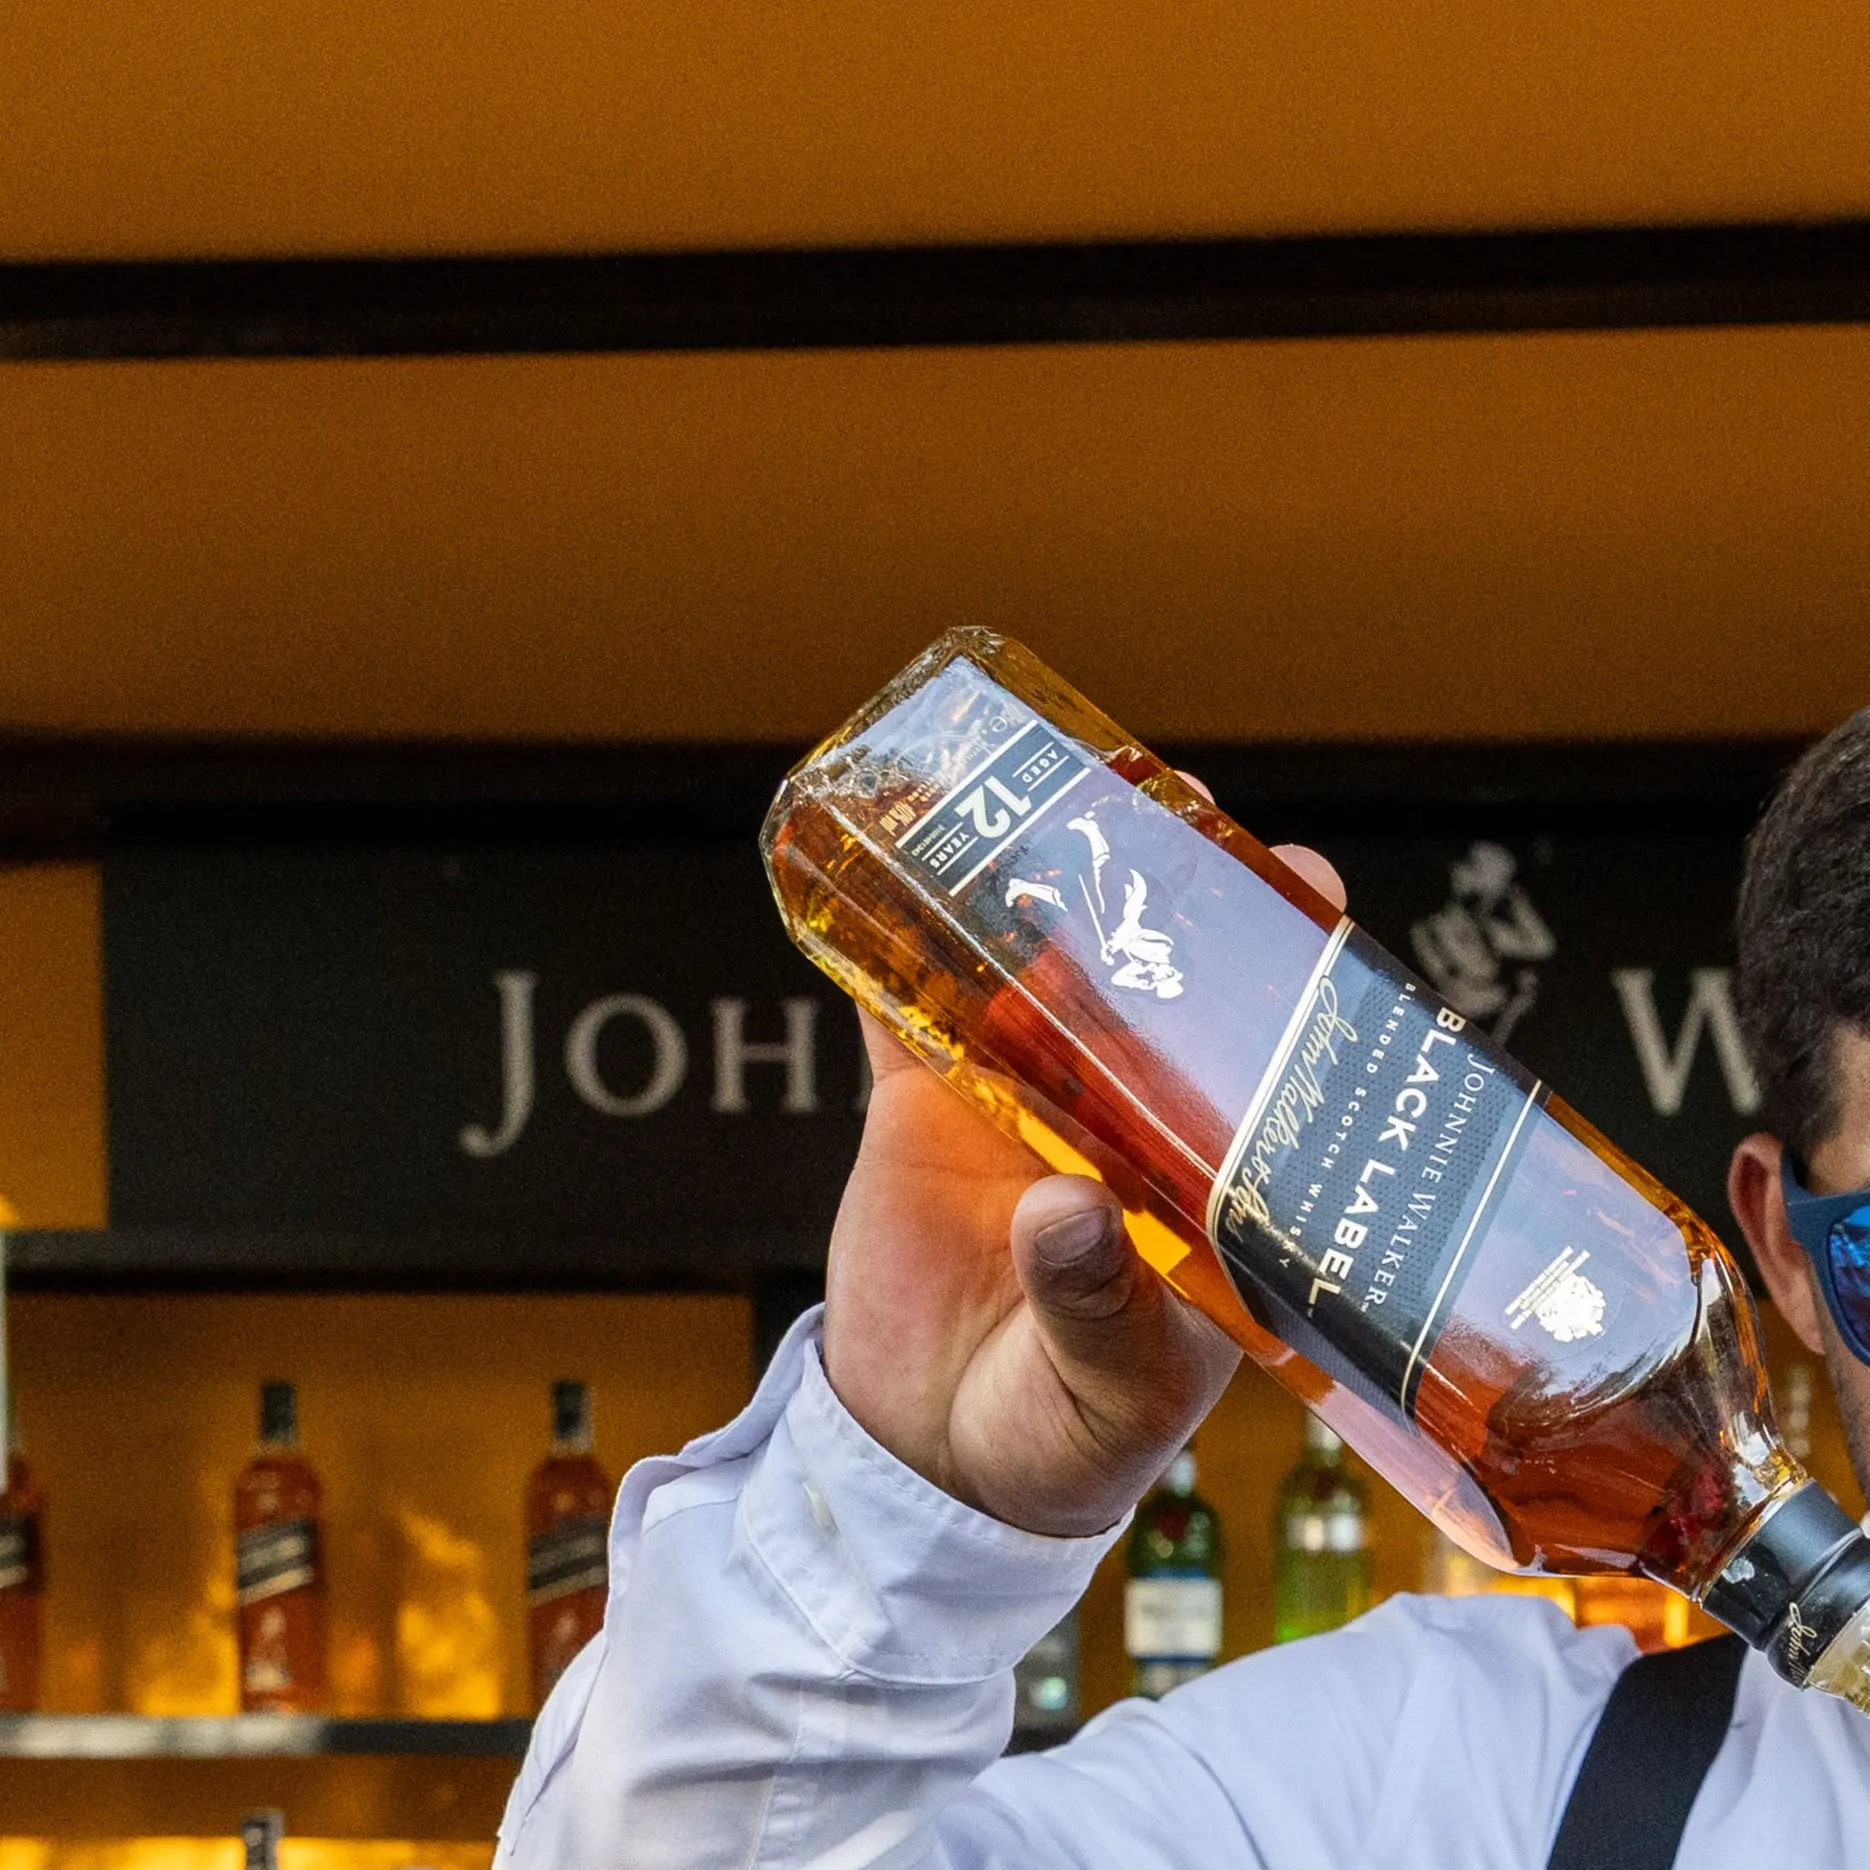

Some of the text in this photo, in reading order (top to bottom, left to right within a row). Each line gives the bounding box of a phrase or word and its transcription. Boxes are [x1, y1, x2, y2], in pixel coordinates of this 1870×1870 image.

[953, 775, 1032, 838] 12
[1020, 748, 1059, 783] AGED
[928, 829, 970, 869] YEARS
[458, 966, 1762, 1158] JOH W
[1277, 983, 1415, 1267] BLENDED SCOTCH WHISKY
[1420, 1053, 1494, 1184] JOHNNIE
[1308, 1005, 1467, 1306] BLACK LABEL
